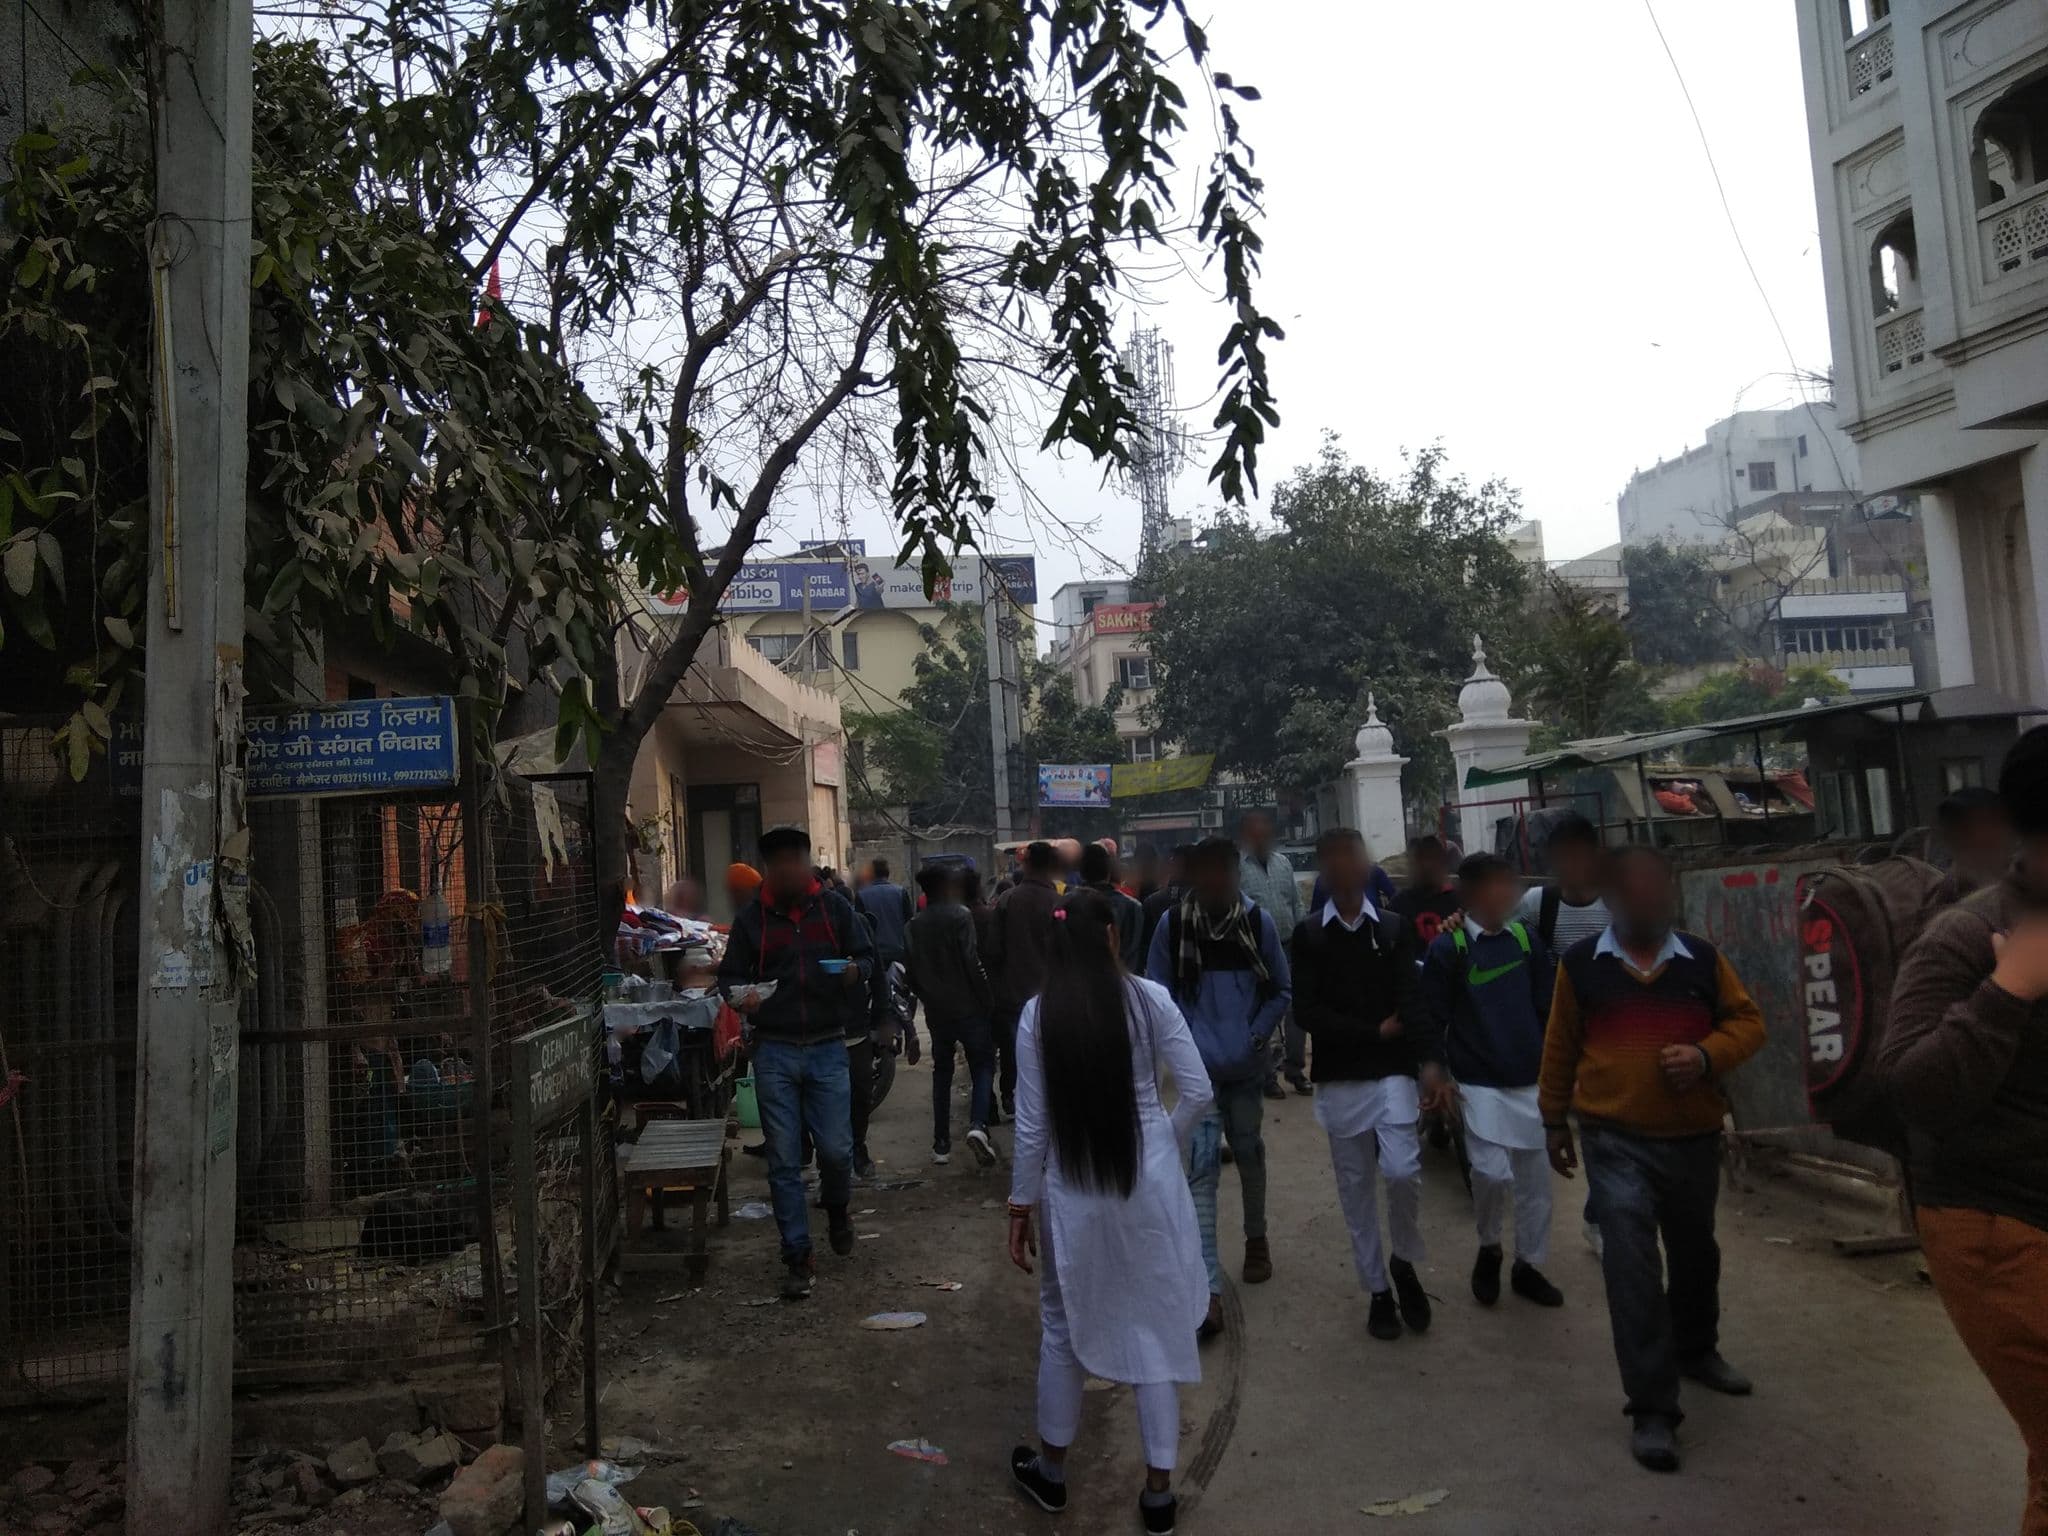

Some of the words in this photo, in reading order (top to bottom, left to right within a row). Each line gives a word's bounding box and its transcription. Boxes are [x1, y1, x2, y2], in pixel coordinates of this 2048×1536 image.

[741, 568, 757, 579] US
[759, 567, 778, 579] ON
[810, 575, 833, 585] OTEL
[890, 582, 922, 593] make
[952, 580, 974, 593] trip
[283, 734, 312, 756] जी
[318, 733, 373, 755] संगत
[378, 730, 442, 752] निवास
